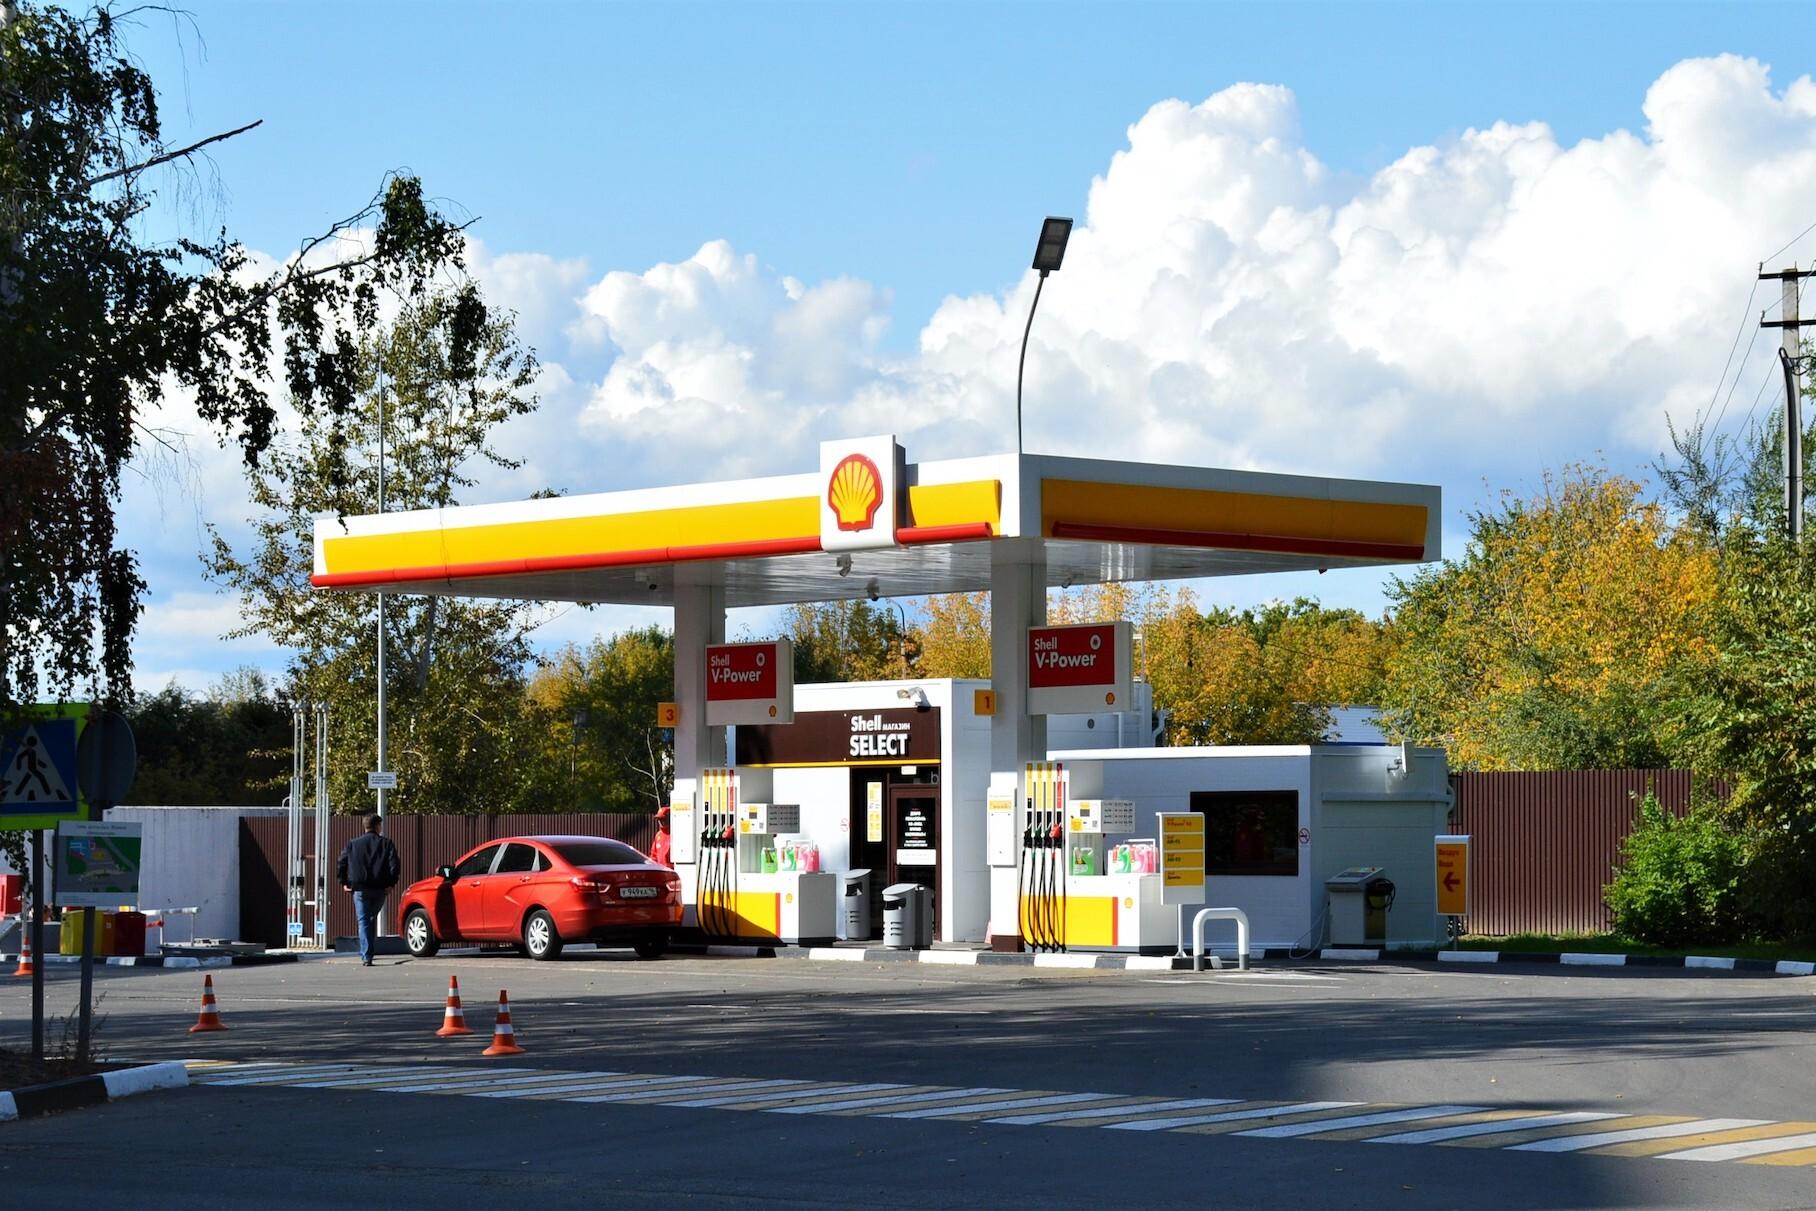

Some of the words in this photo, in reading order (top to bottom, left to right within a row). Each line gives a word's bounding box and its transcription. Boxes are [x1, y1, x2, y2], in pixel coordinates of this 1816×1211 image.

[1034, 636, 1058, 650] Shell
[711, 654, 730, 667] Shell
[1035, 651, 1097, 668] V-Power
[711, 668, 762, 683] V-Power
[984, 696, 990, 709] 1
[666, 709, 674, 721] 3
[851, 714, 882, 732] Shell
[850, 733, 908, 756] SELECT
